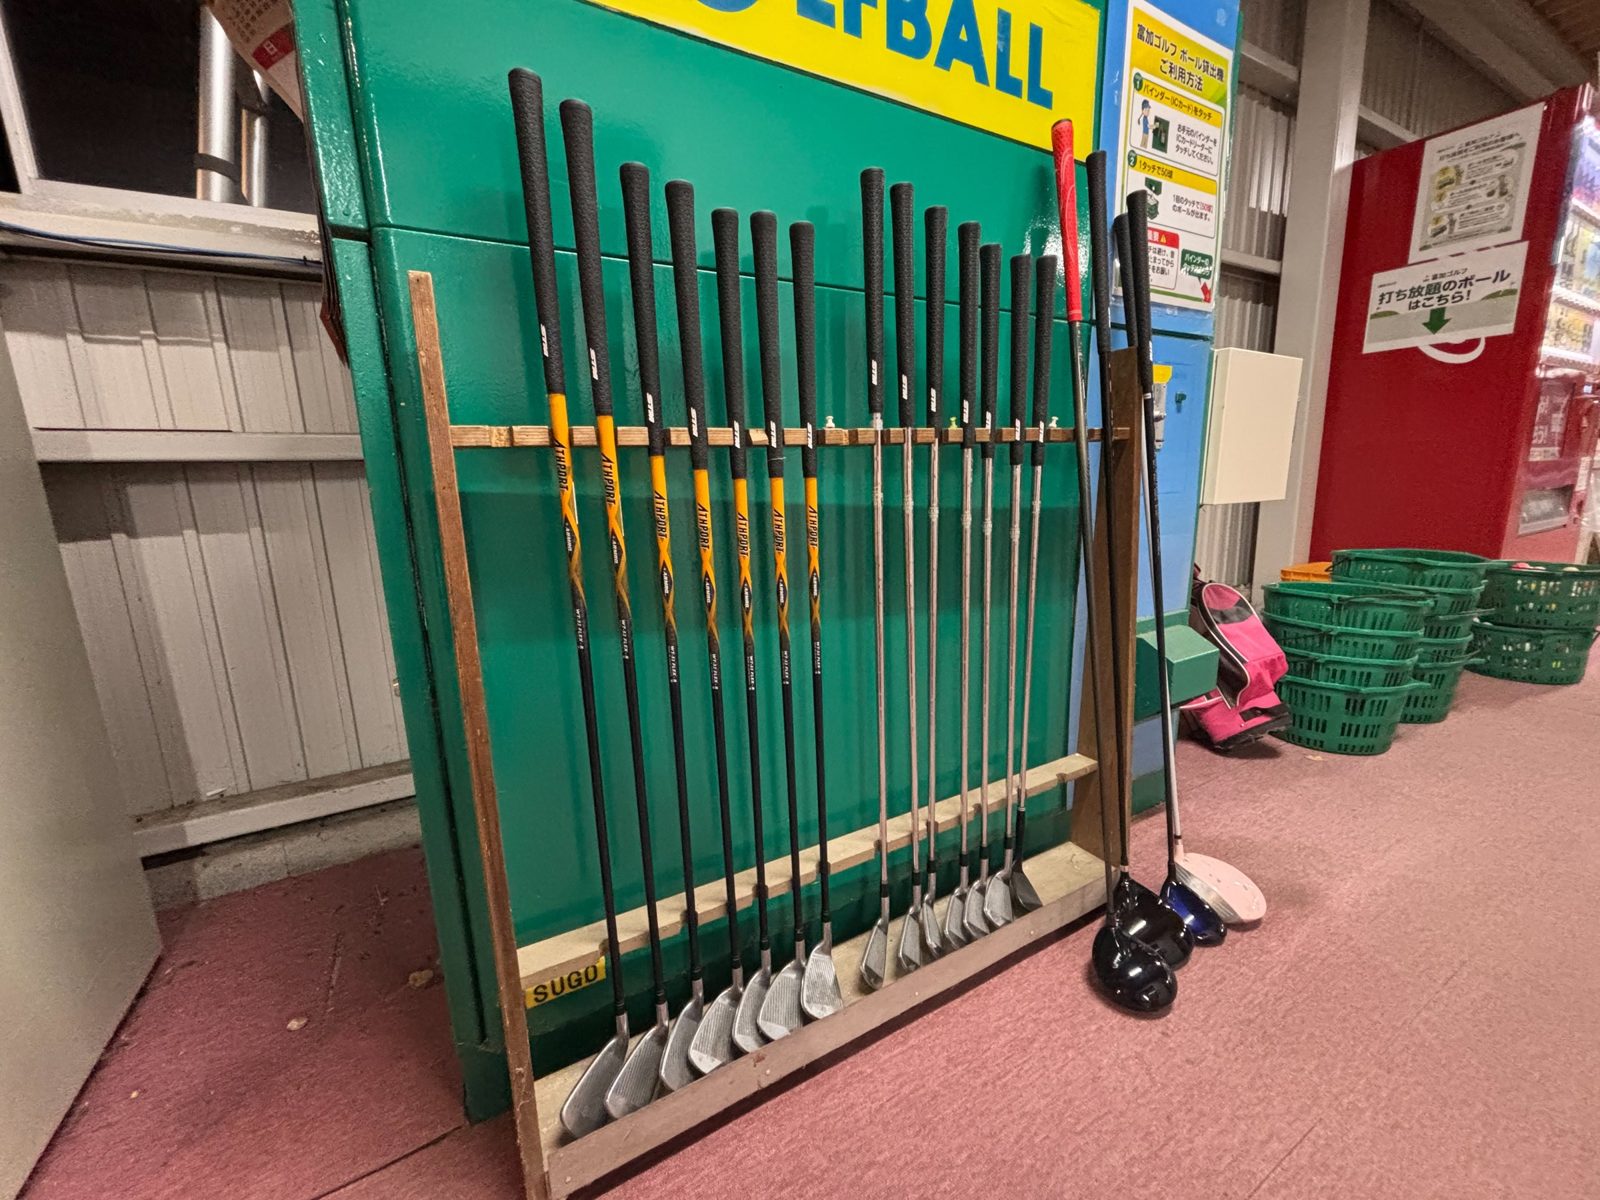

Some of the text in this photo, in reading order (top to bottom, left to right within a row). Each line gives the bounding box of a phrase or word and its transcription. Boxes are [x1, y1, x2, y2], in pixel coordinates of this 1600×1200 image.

[1137, 23, 1177, 56] 富加ゴルフ
[1160, 58, 1203, 91] ご利用方法
[1378, 269, 1511, 305] 打ち放題のボール
[533, 964, 598, 1004] SUGO
